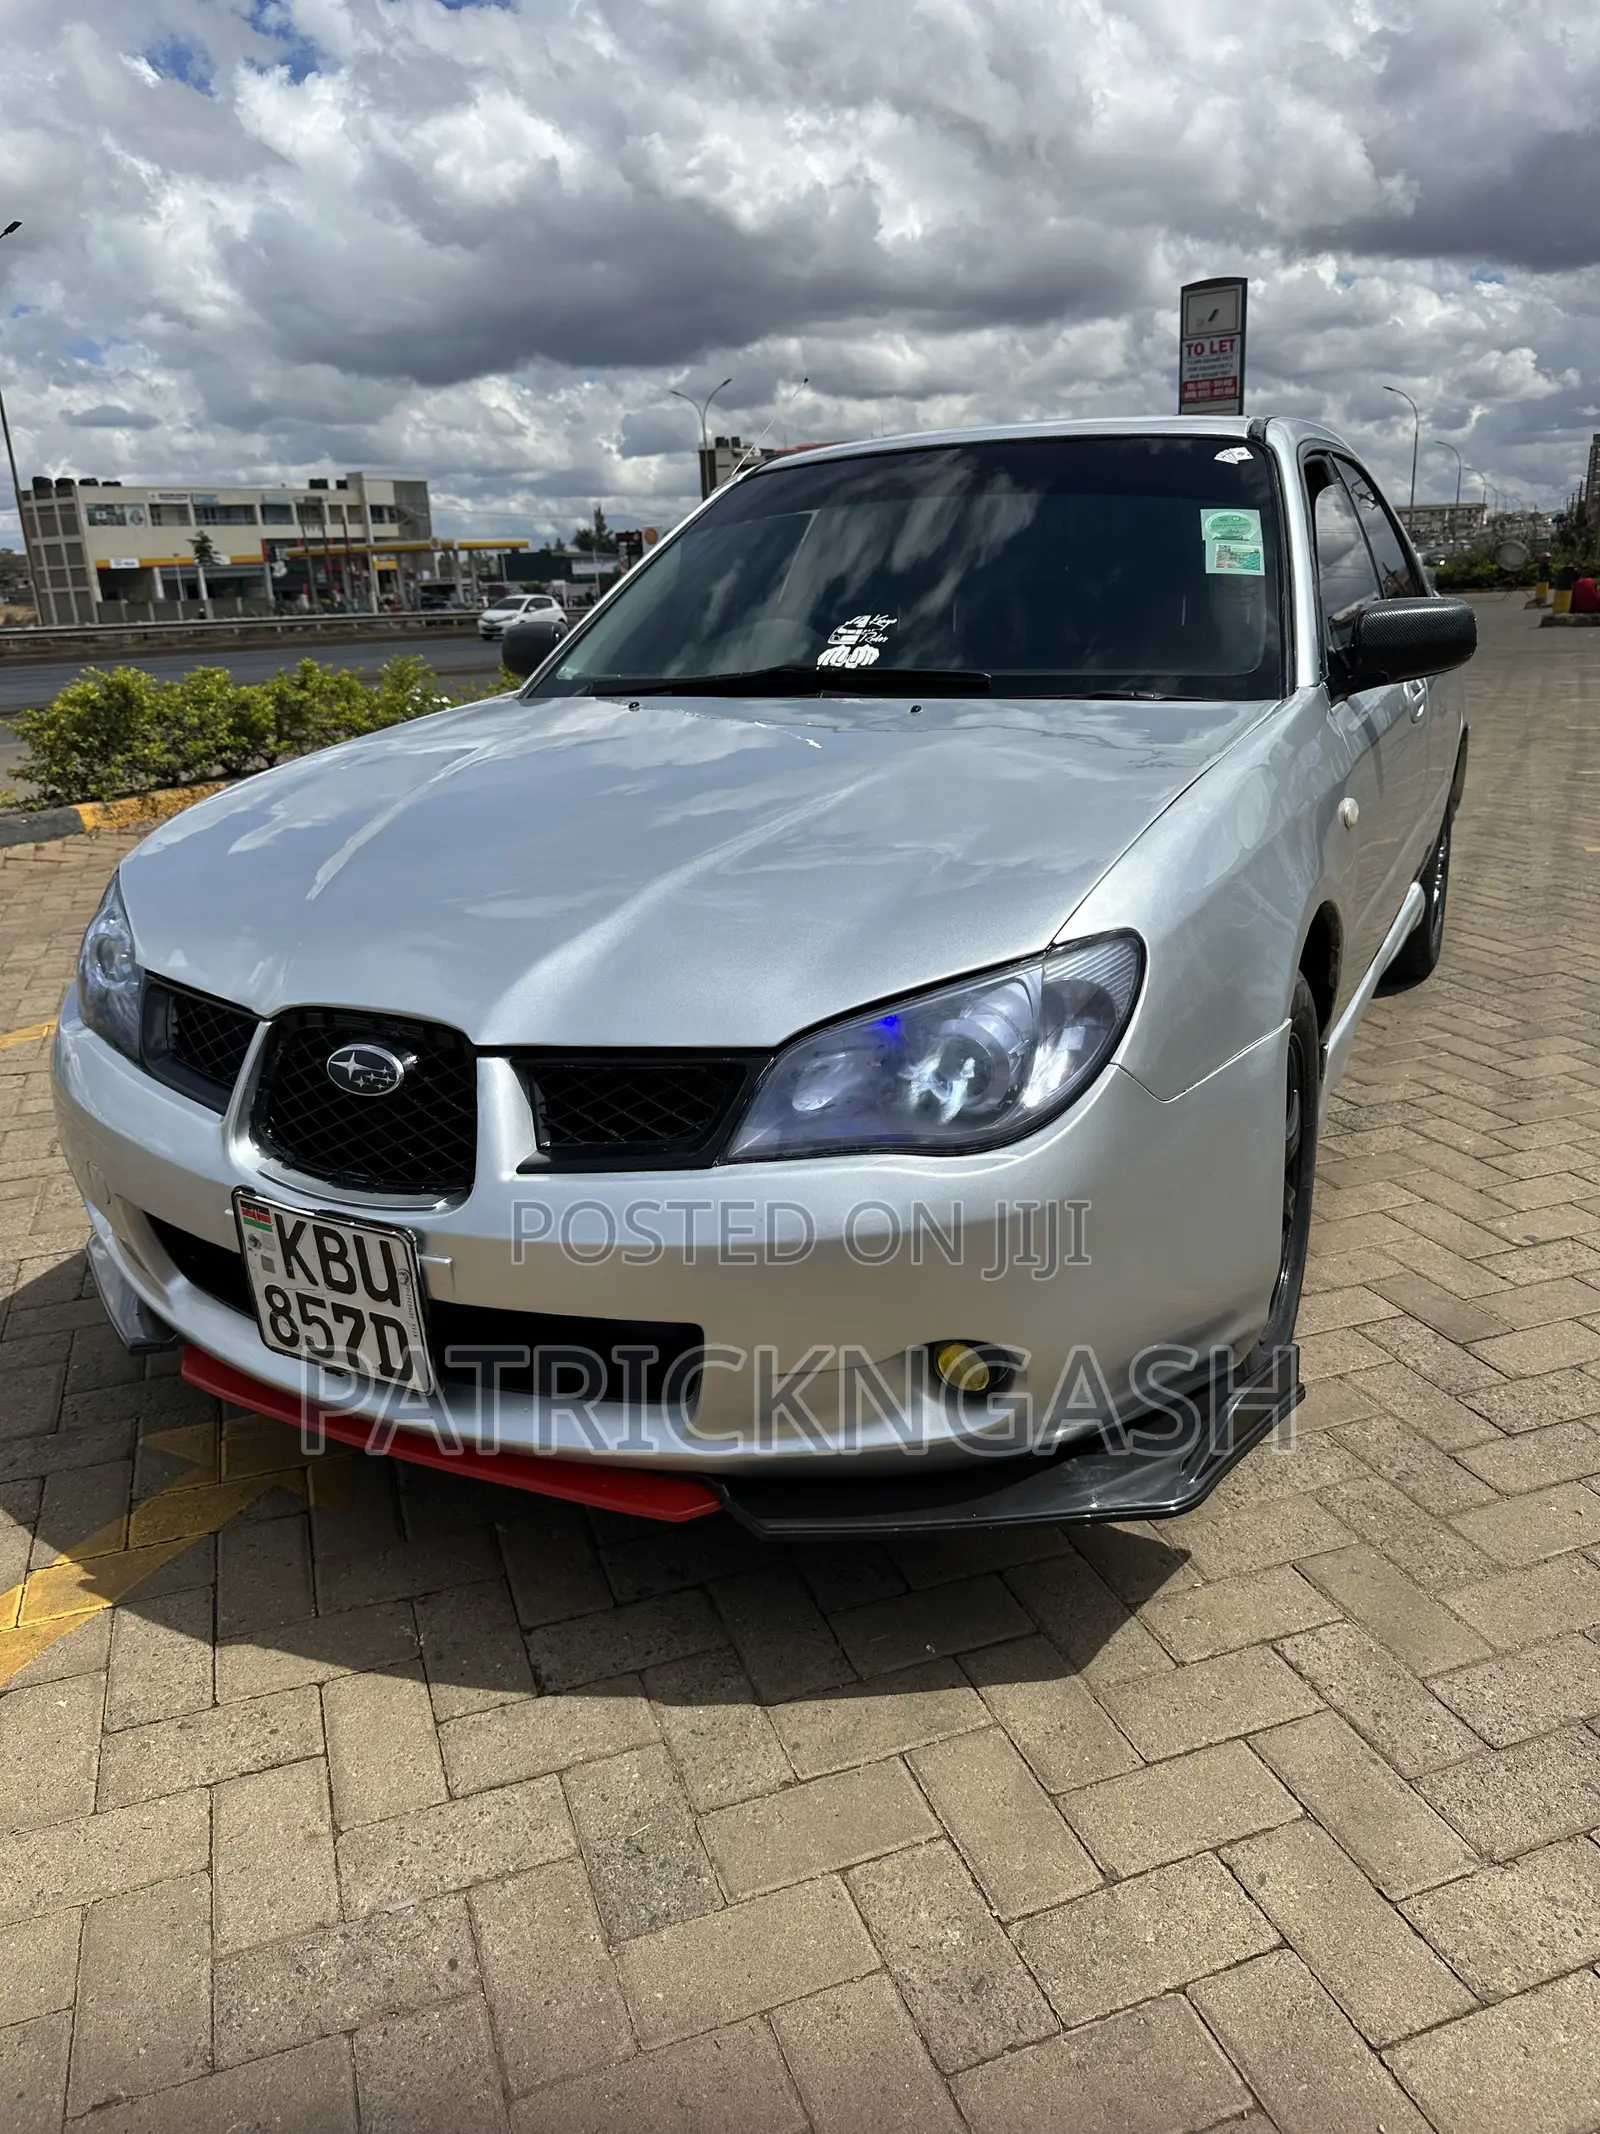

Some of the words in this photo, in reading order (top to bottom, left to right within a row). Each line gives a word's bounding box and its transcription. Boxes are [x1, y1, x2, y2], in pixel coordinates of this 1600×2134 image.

[1185, 341, 1205, 357] TO
[1209, 338, 1236, 354] LET
[274, 1212, 401, 1307] KBU
[264, 1284, 413, 1381] 857D
